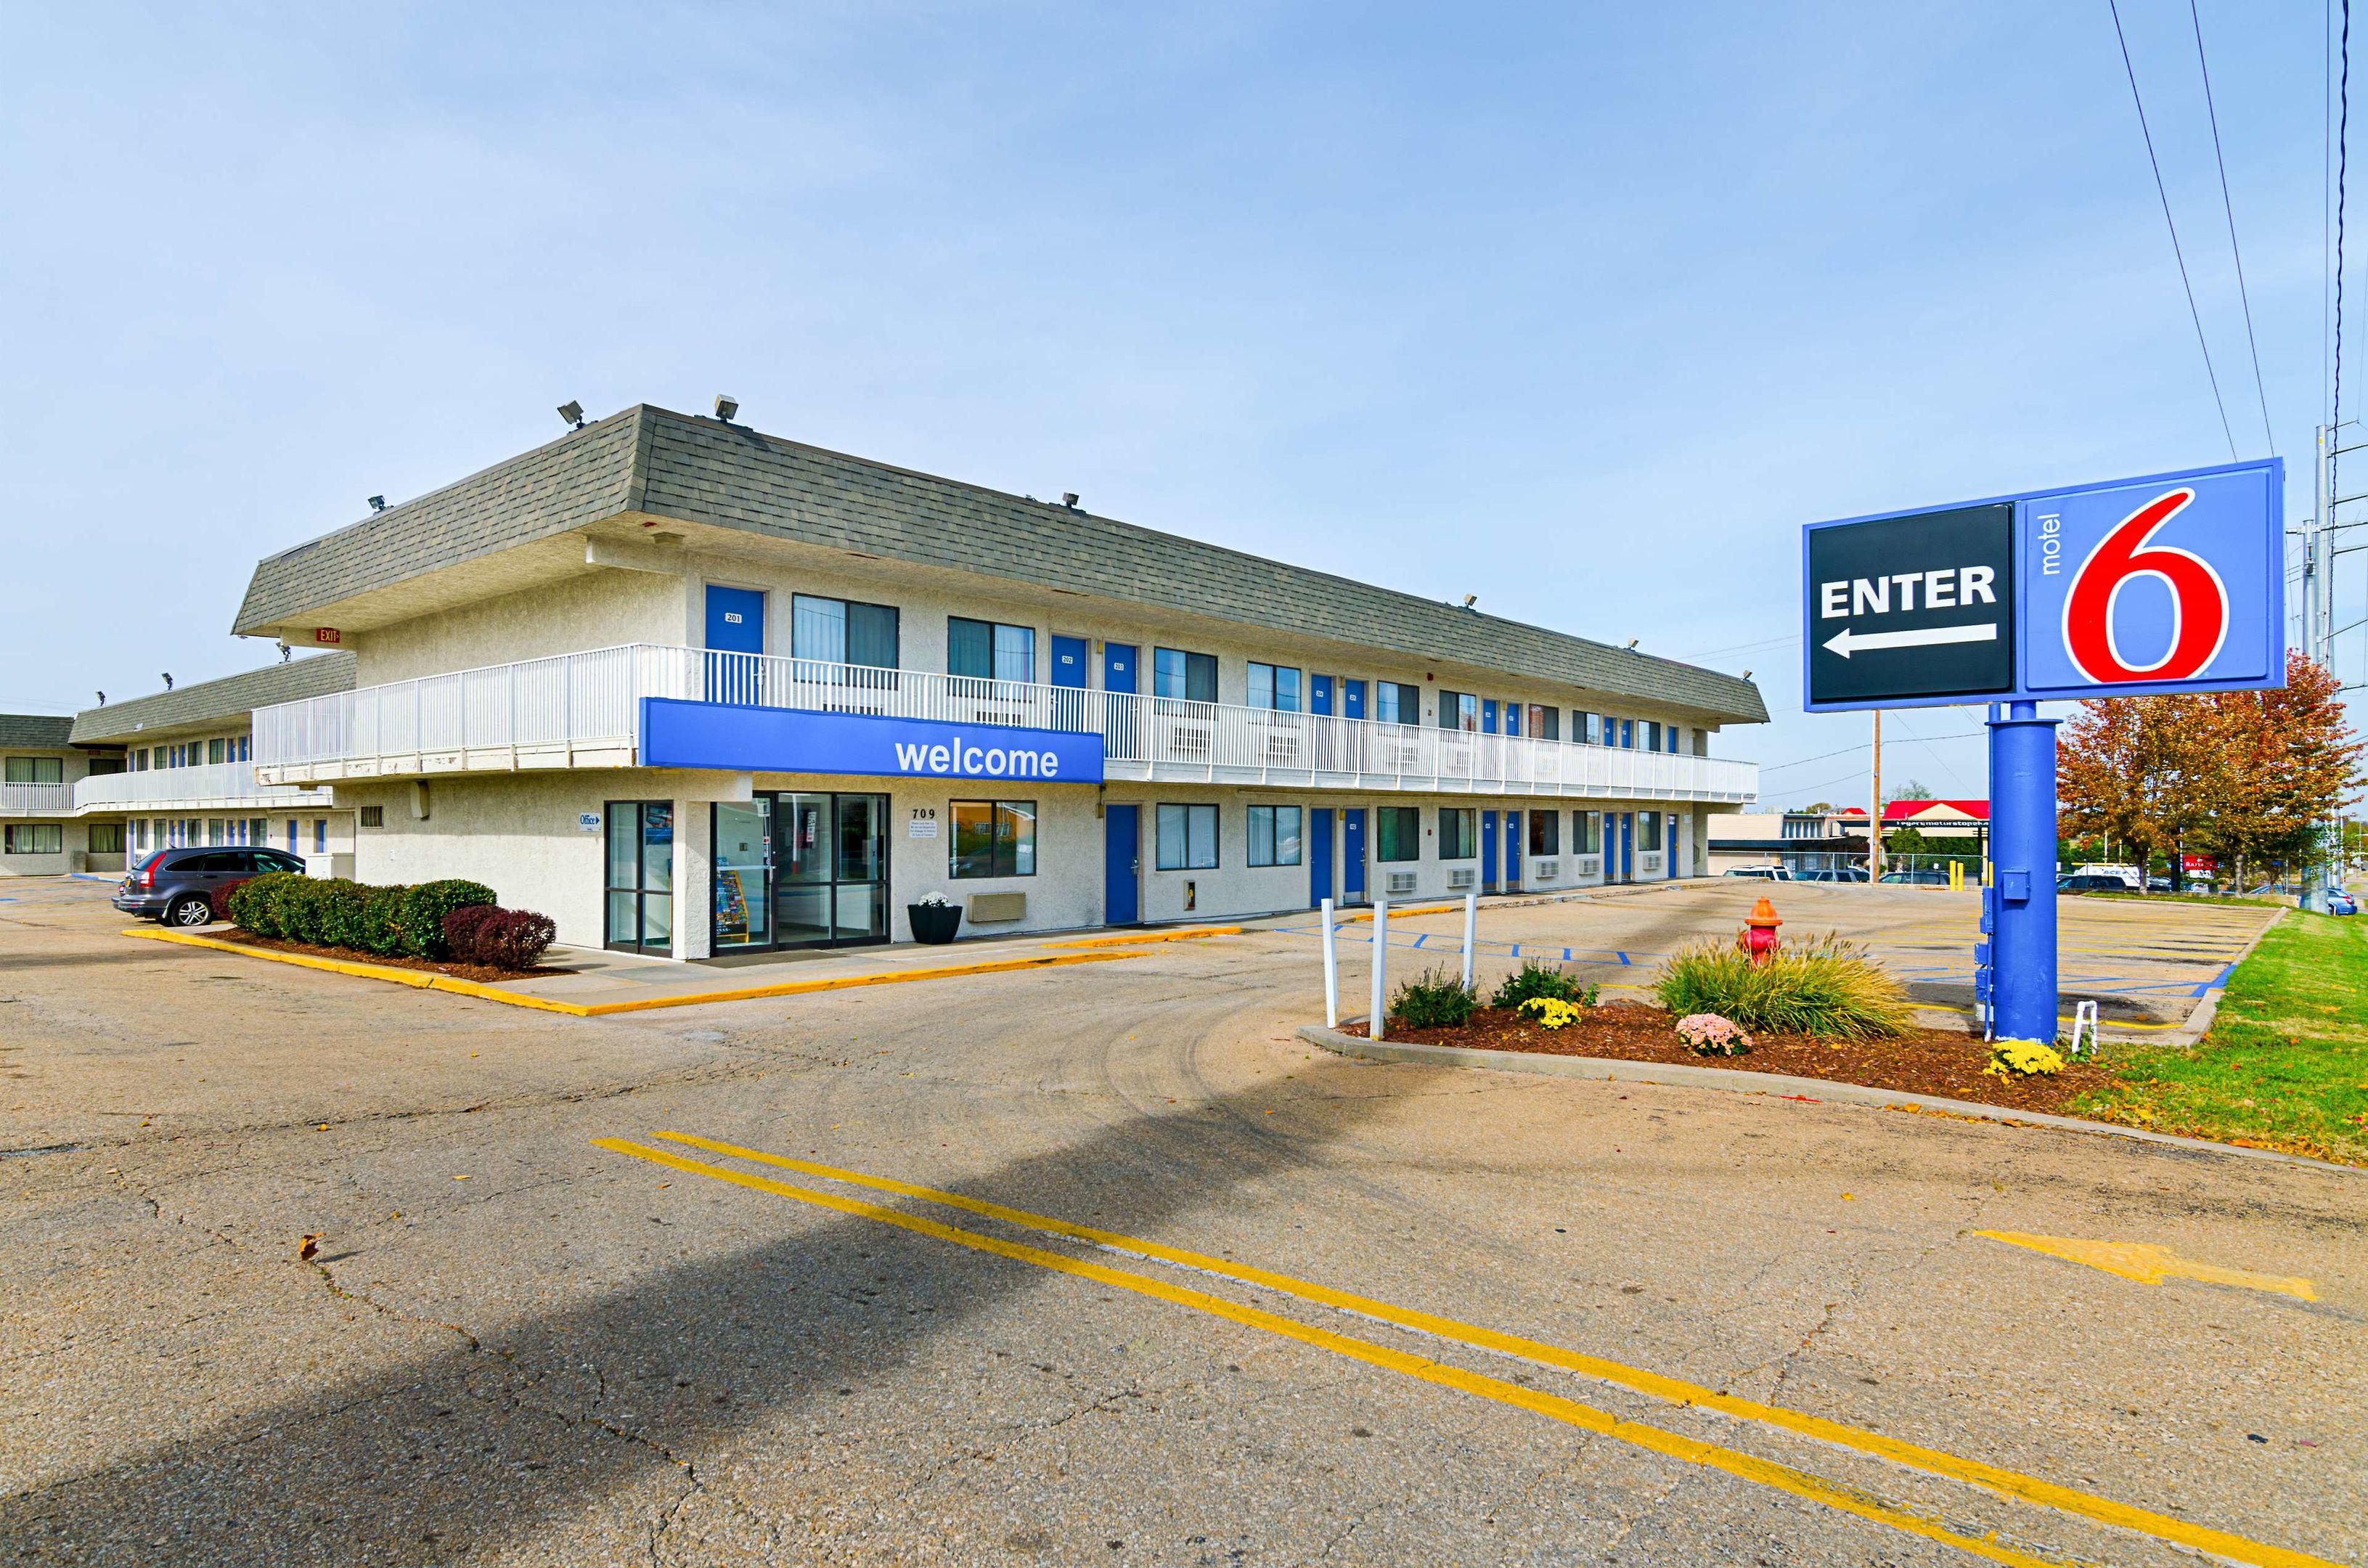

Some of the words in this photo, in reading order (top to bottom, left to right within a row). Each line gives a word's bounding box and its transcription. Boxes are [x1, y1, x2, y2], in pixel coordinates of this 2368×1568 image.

[2037, 513, 2061, 576] motel
[1821, 565, 1997, 619] ENTER
[2061, 486, 2230, 684] 6
[727, 613, 740, 622] 201
[320, 629, 338, 642] EXIT
[894, 736, 1059, 777] welcome
[580, 814, 596, 825] Office
[913, 808, 936, 820] 709
